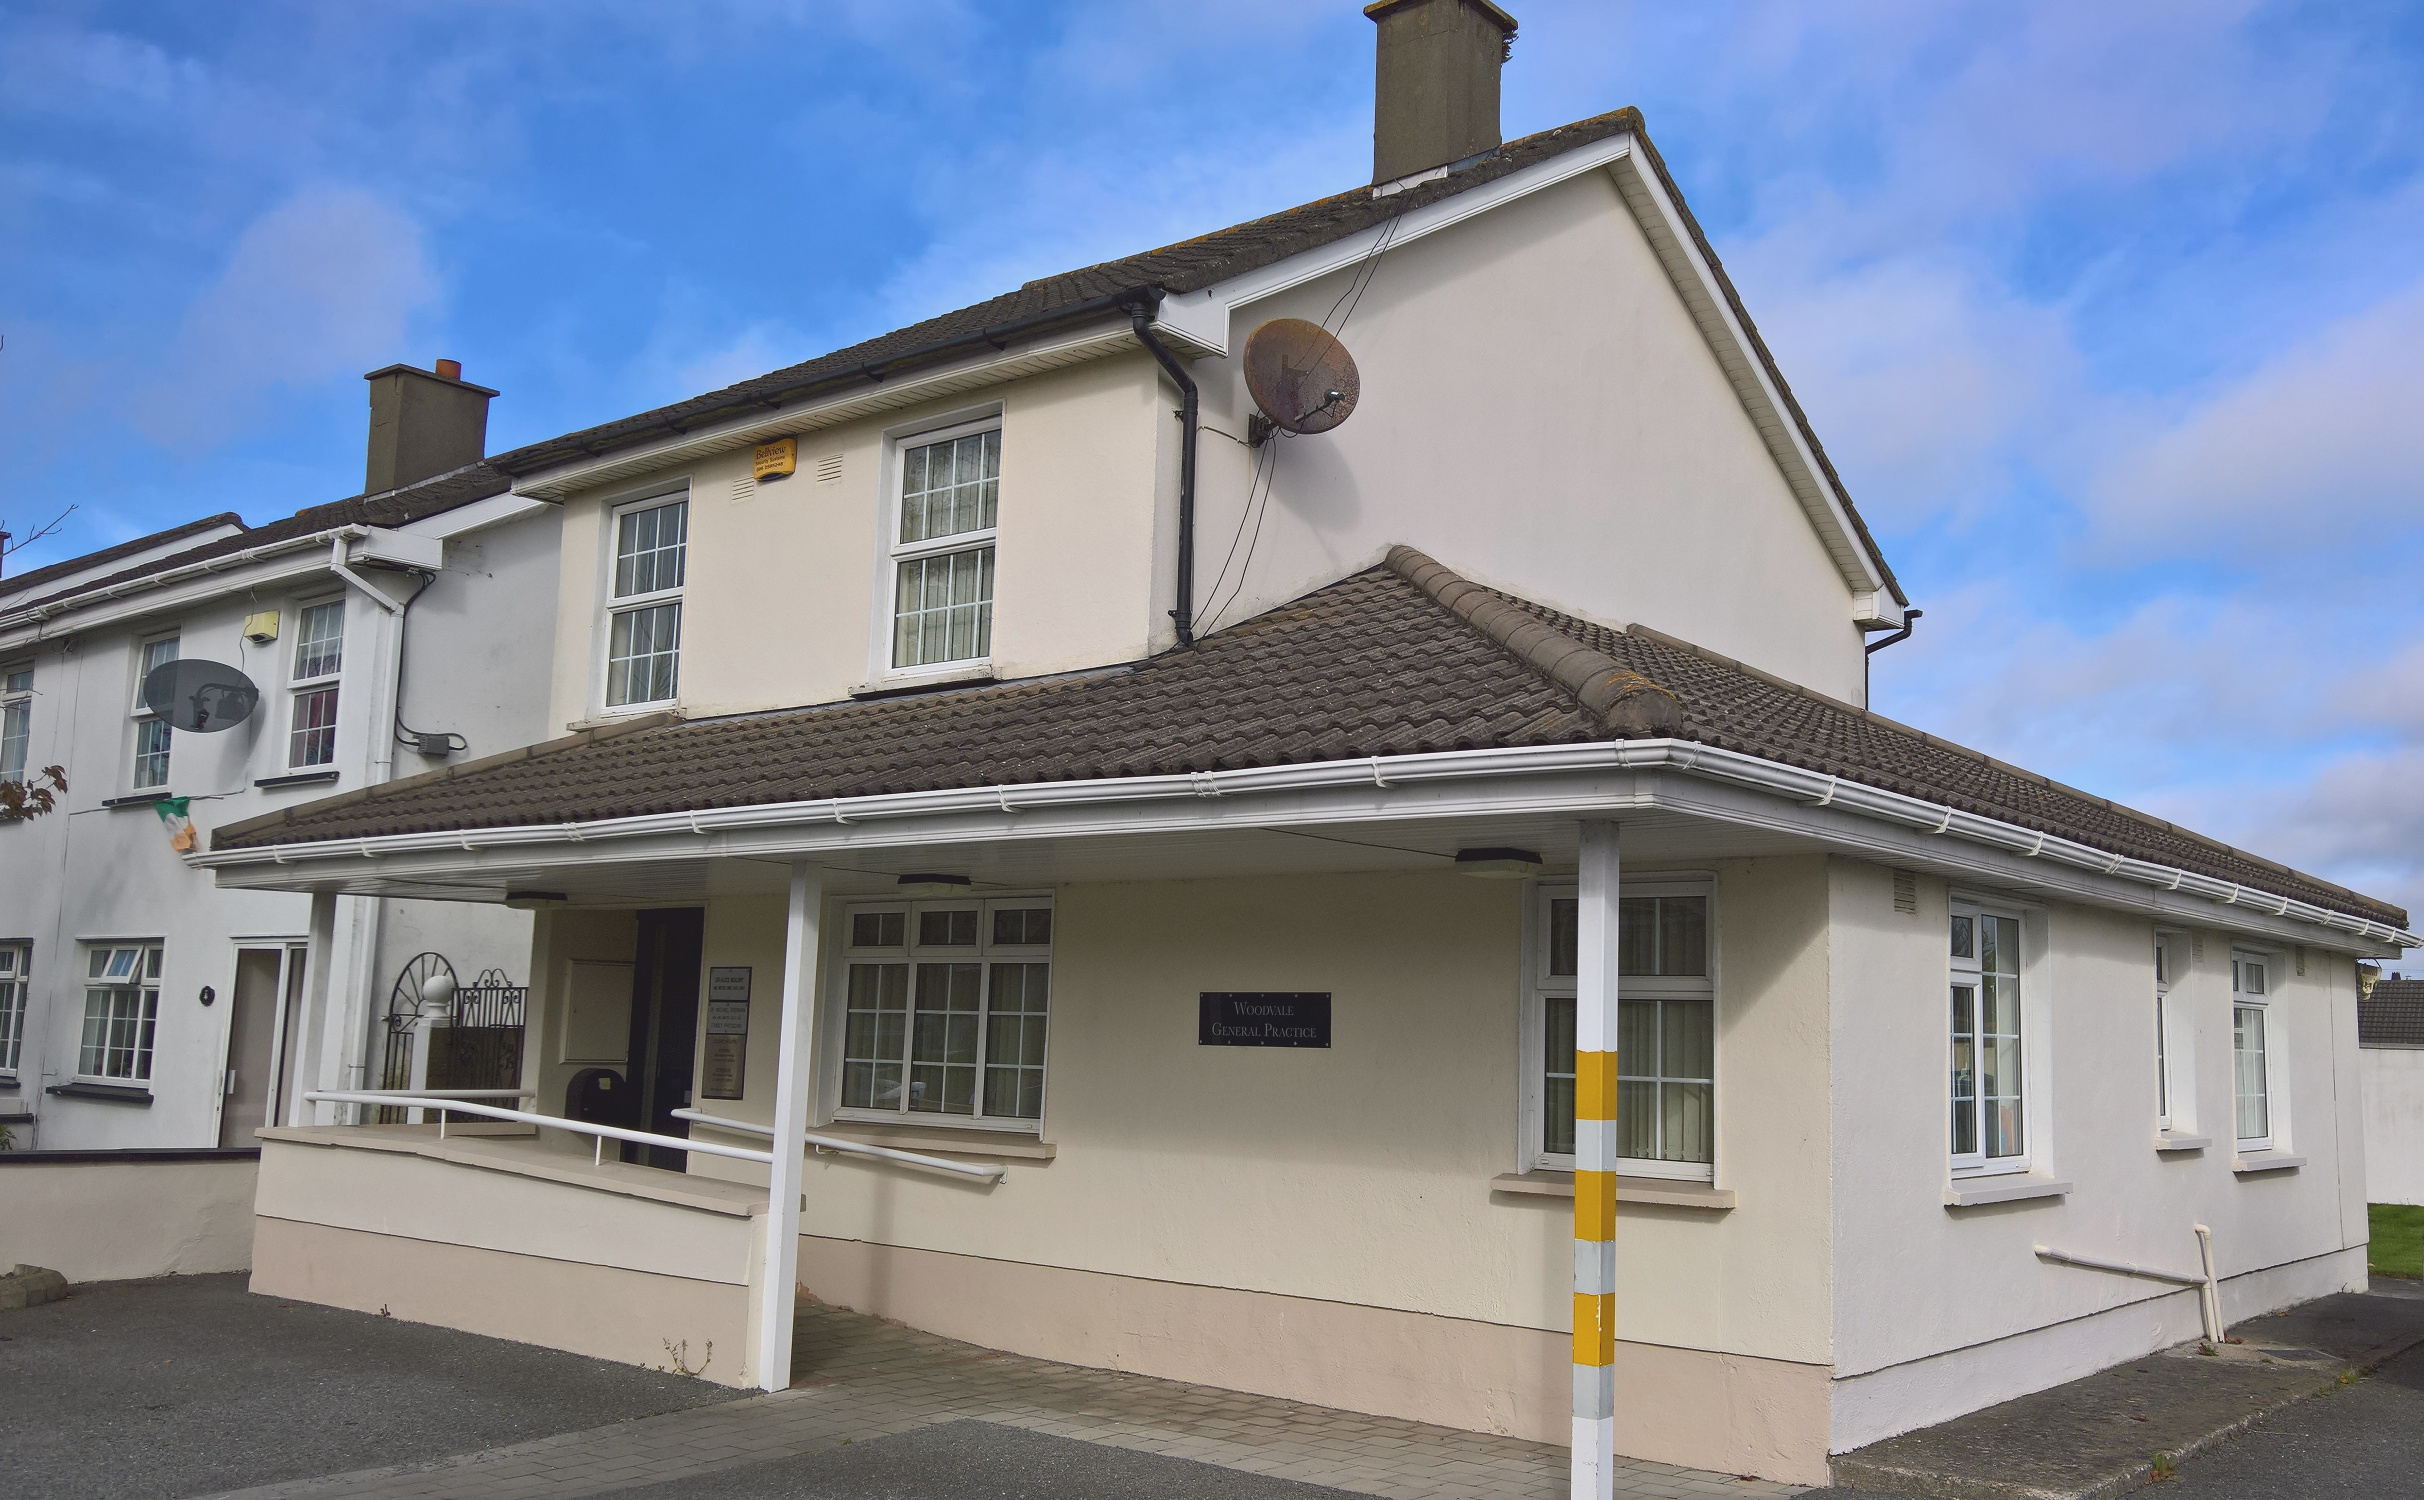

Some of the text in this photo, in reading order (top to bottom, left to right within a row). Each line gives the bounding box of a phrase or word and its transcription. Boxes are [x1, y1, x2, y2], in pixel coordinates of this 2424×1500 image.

[756, 446, 787, 460] Bellview
[1234, 1001, 1294, 1016] WOODVALE
[1212, 1022, 1317, 1038] GENERAL PRACTICE
